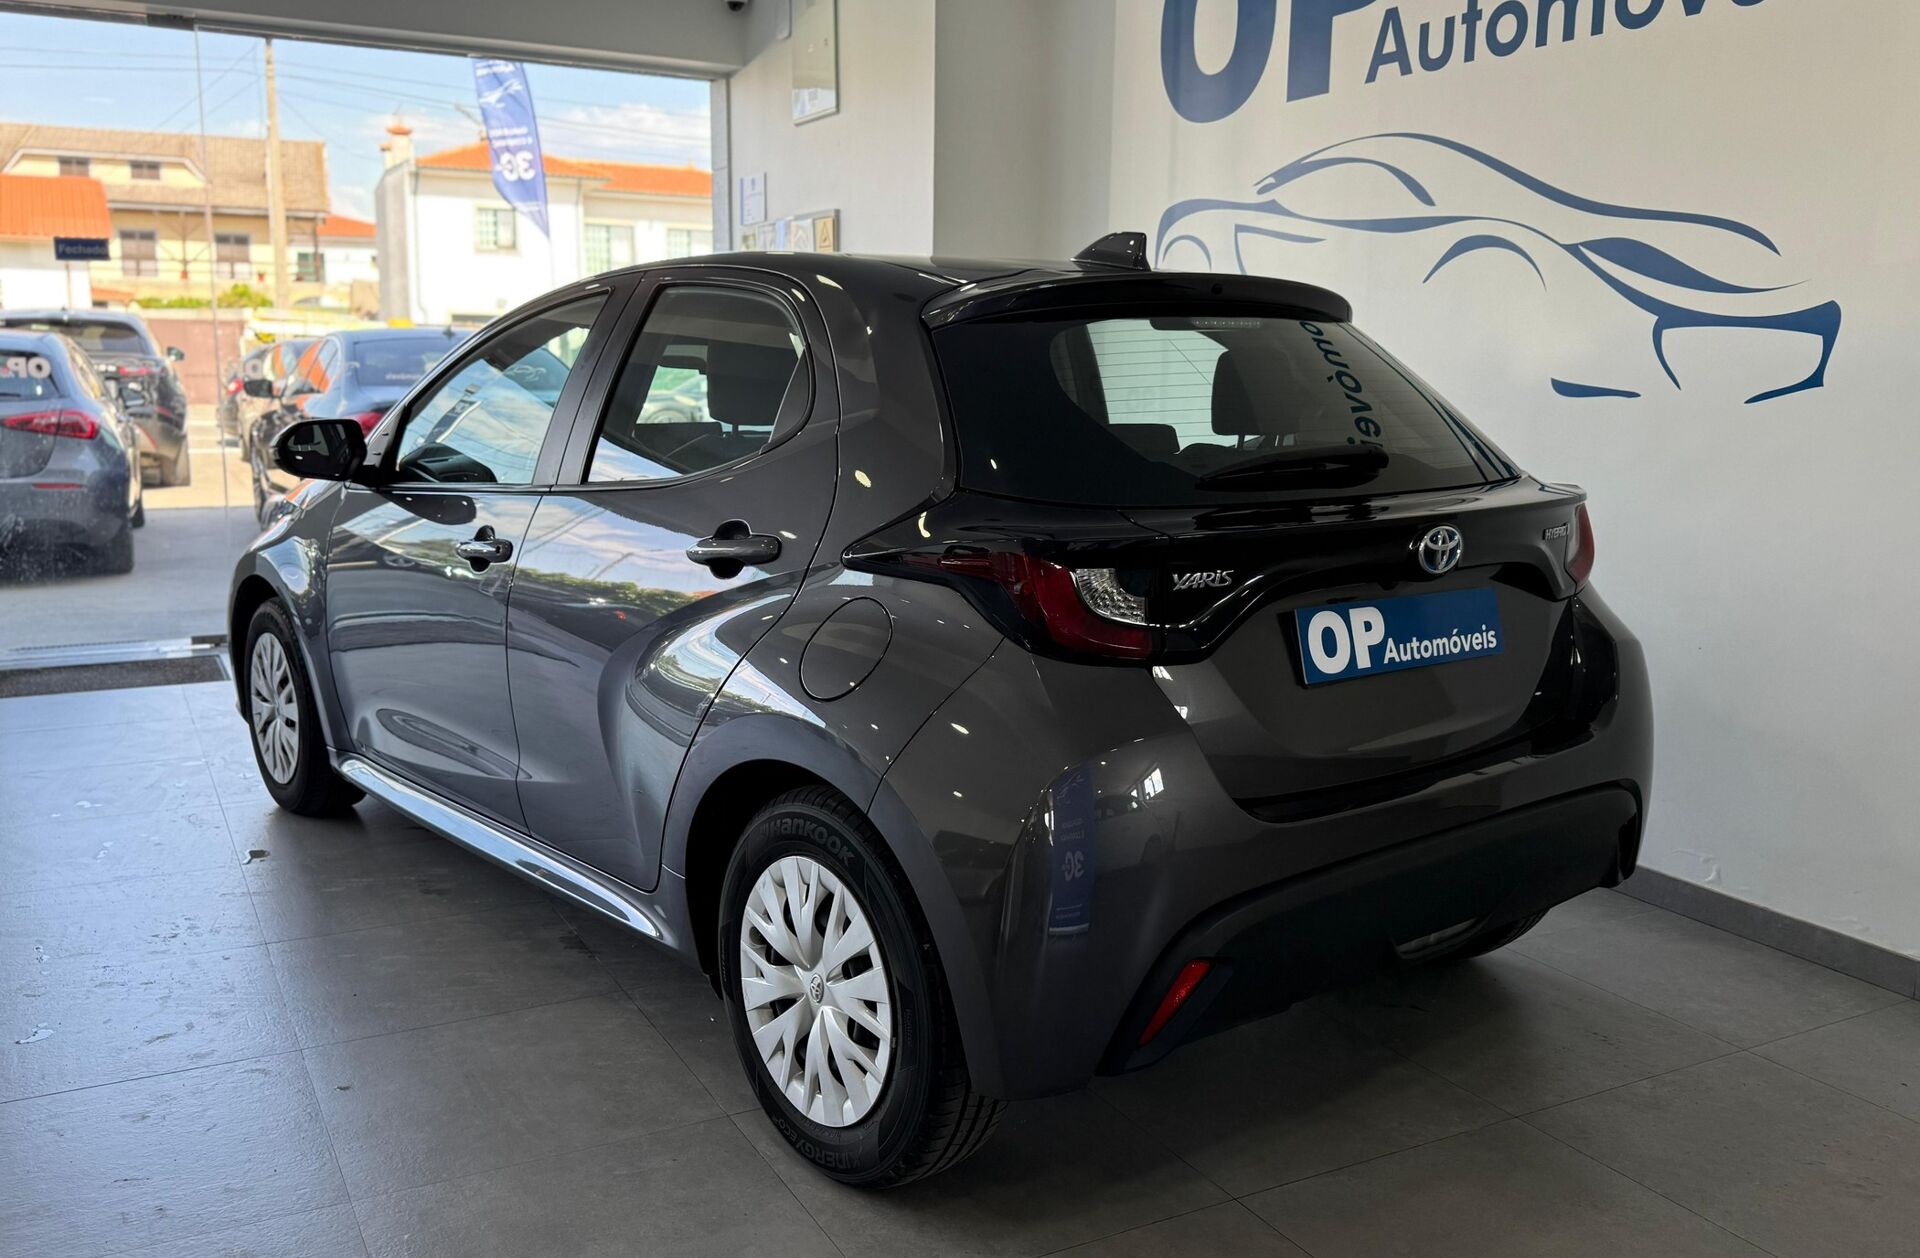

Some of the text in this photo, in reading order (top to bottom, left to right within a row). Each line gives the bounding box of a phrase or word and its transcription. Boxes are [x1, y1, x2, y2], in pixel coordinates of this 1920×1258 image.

[58, 243, 107, 255] Fechado
[1307, 606, 1497, 675] OP Automóveis
